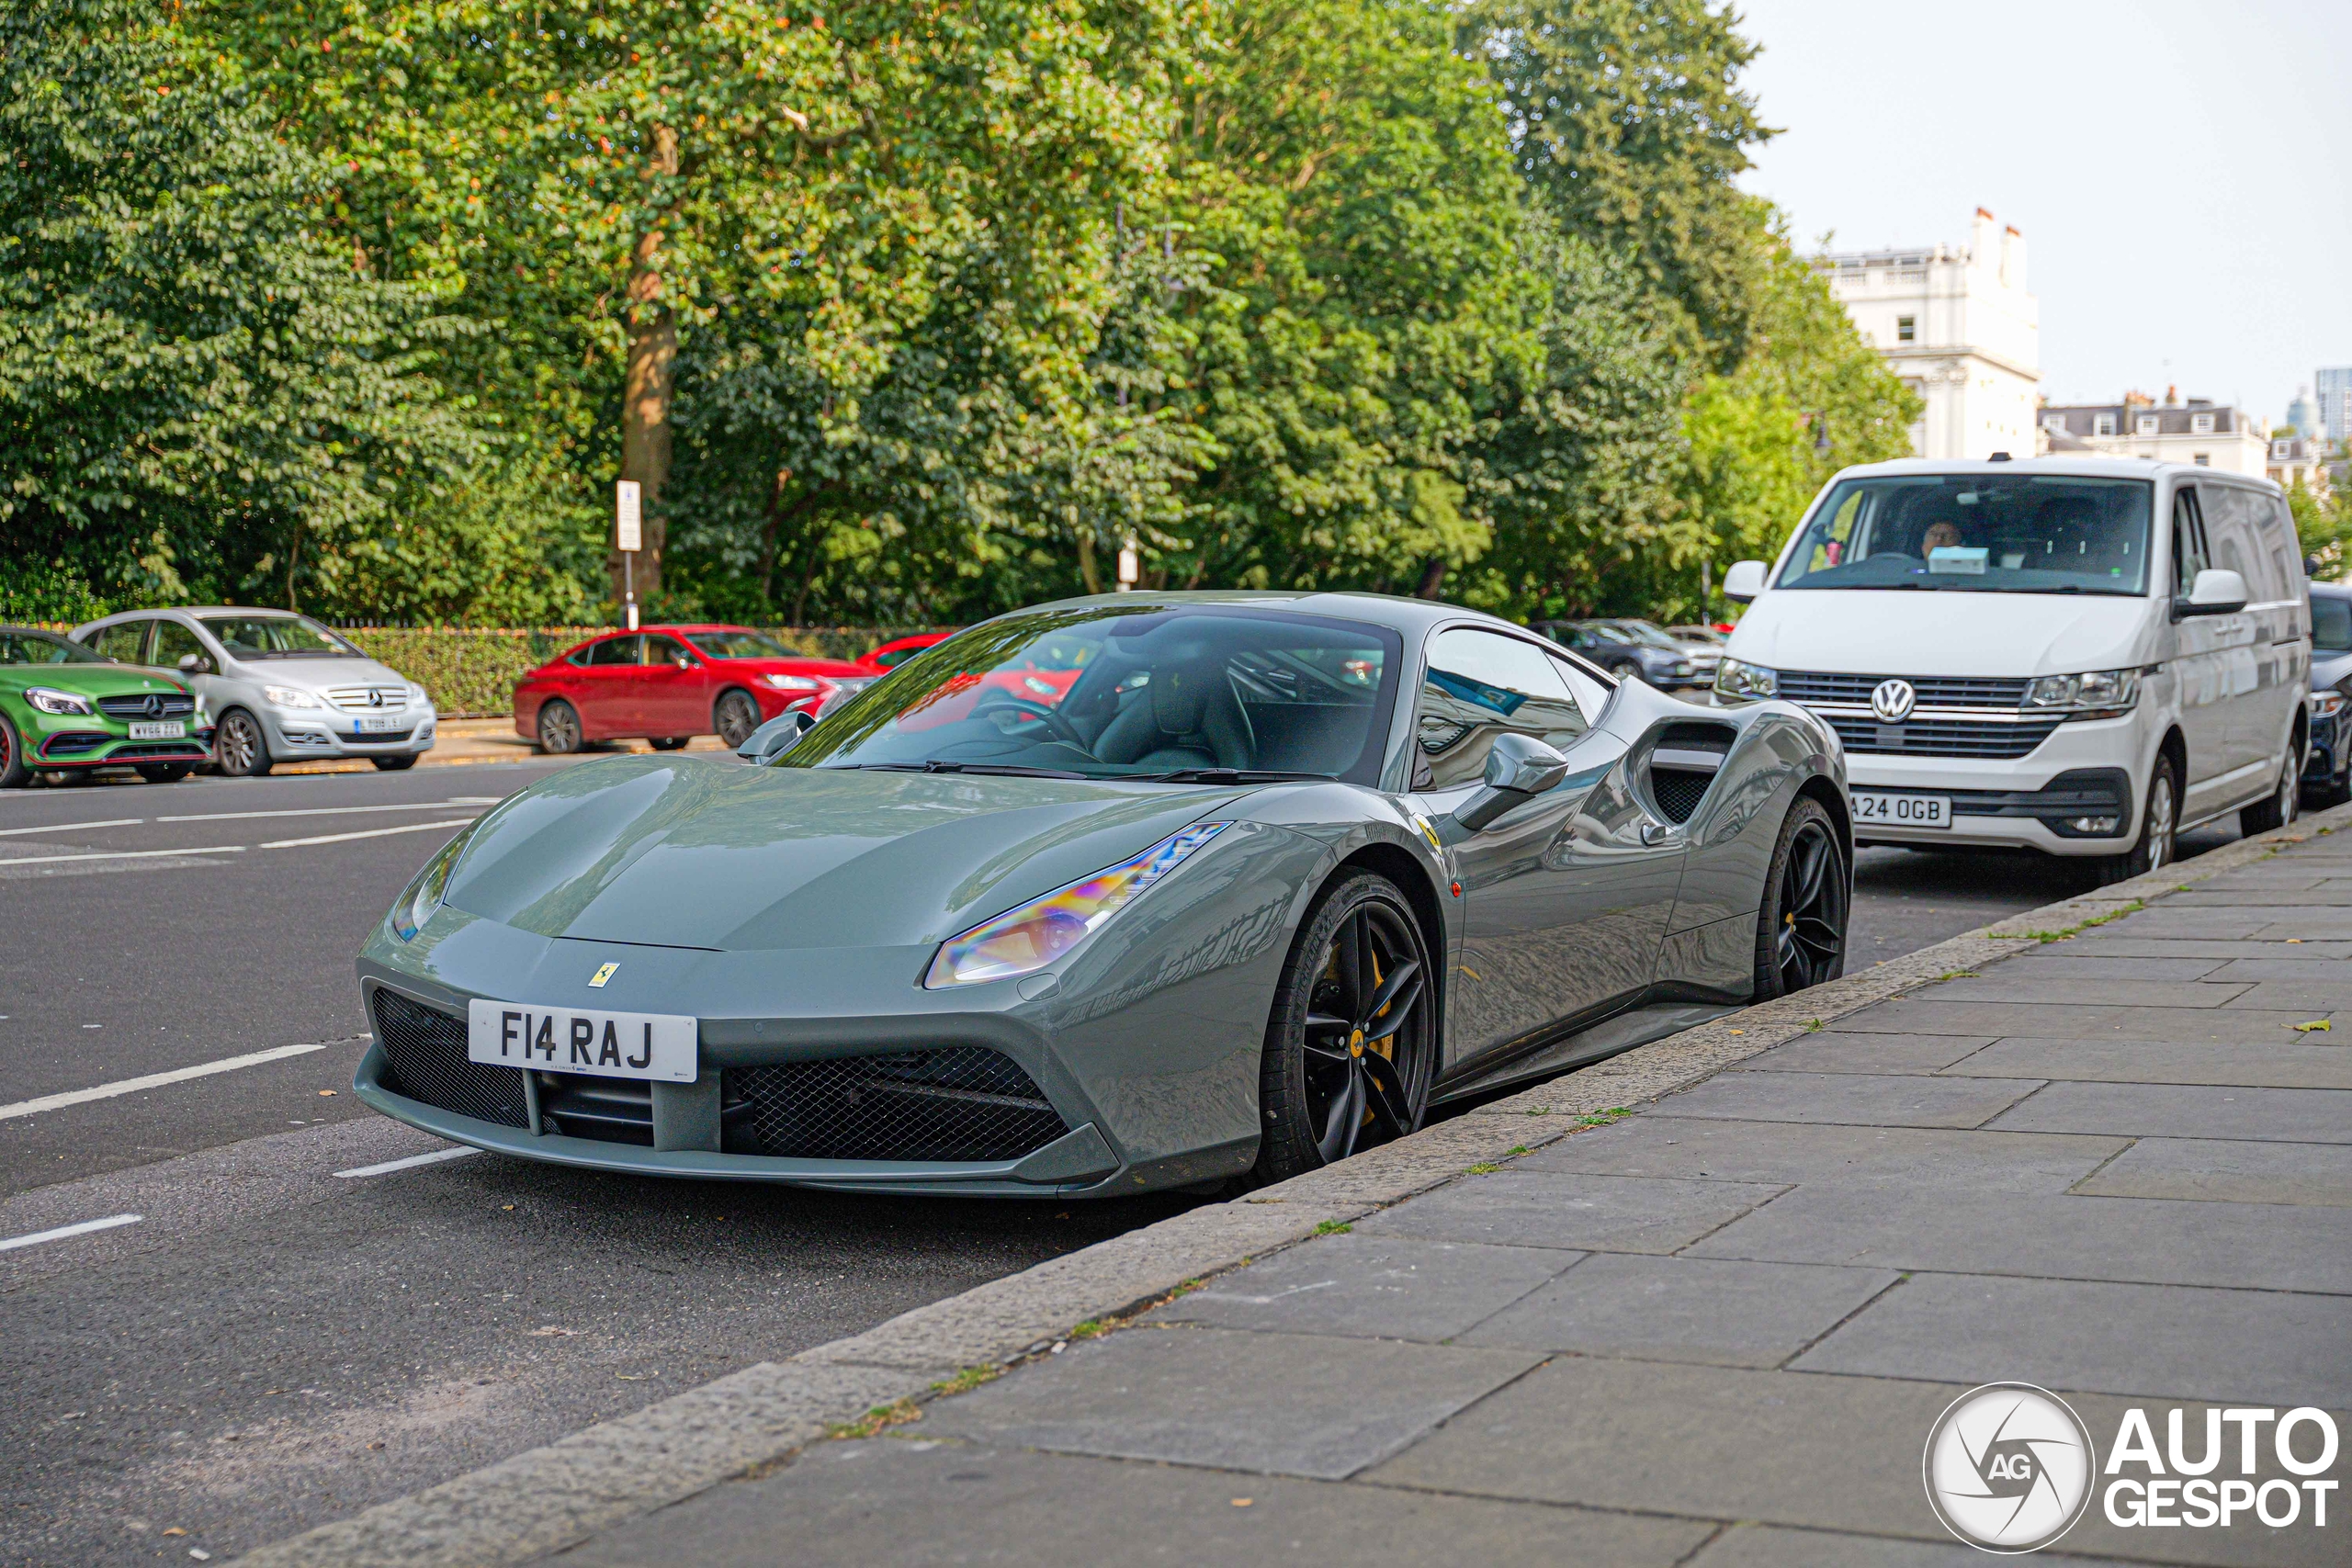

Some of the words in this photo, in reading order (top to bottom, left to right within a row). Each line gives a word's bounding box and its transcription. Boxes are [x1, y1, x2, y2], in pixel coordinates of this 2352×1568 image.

[1897, 799, 1939, 819] OGB
[502, 1010, 557, 1061] F14
[571, 1017, 651, 1069] RAJ
